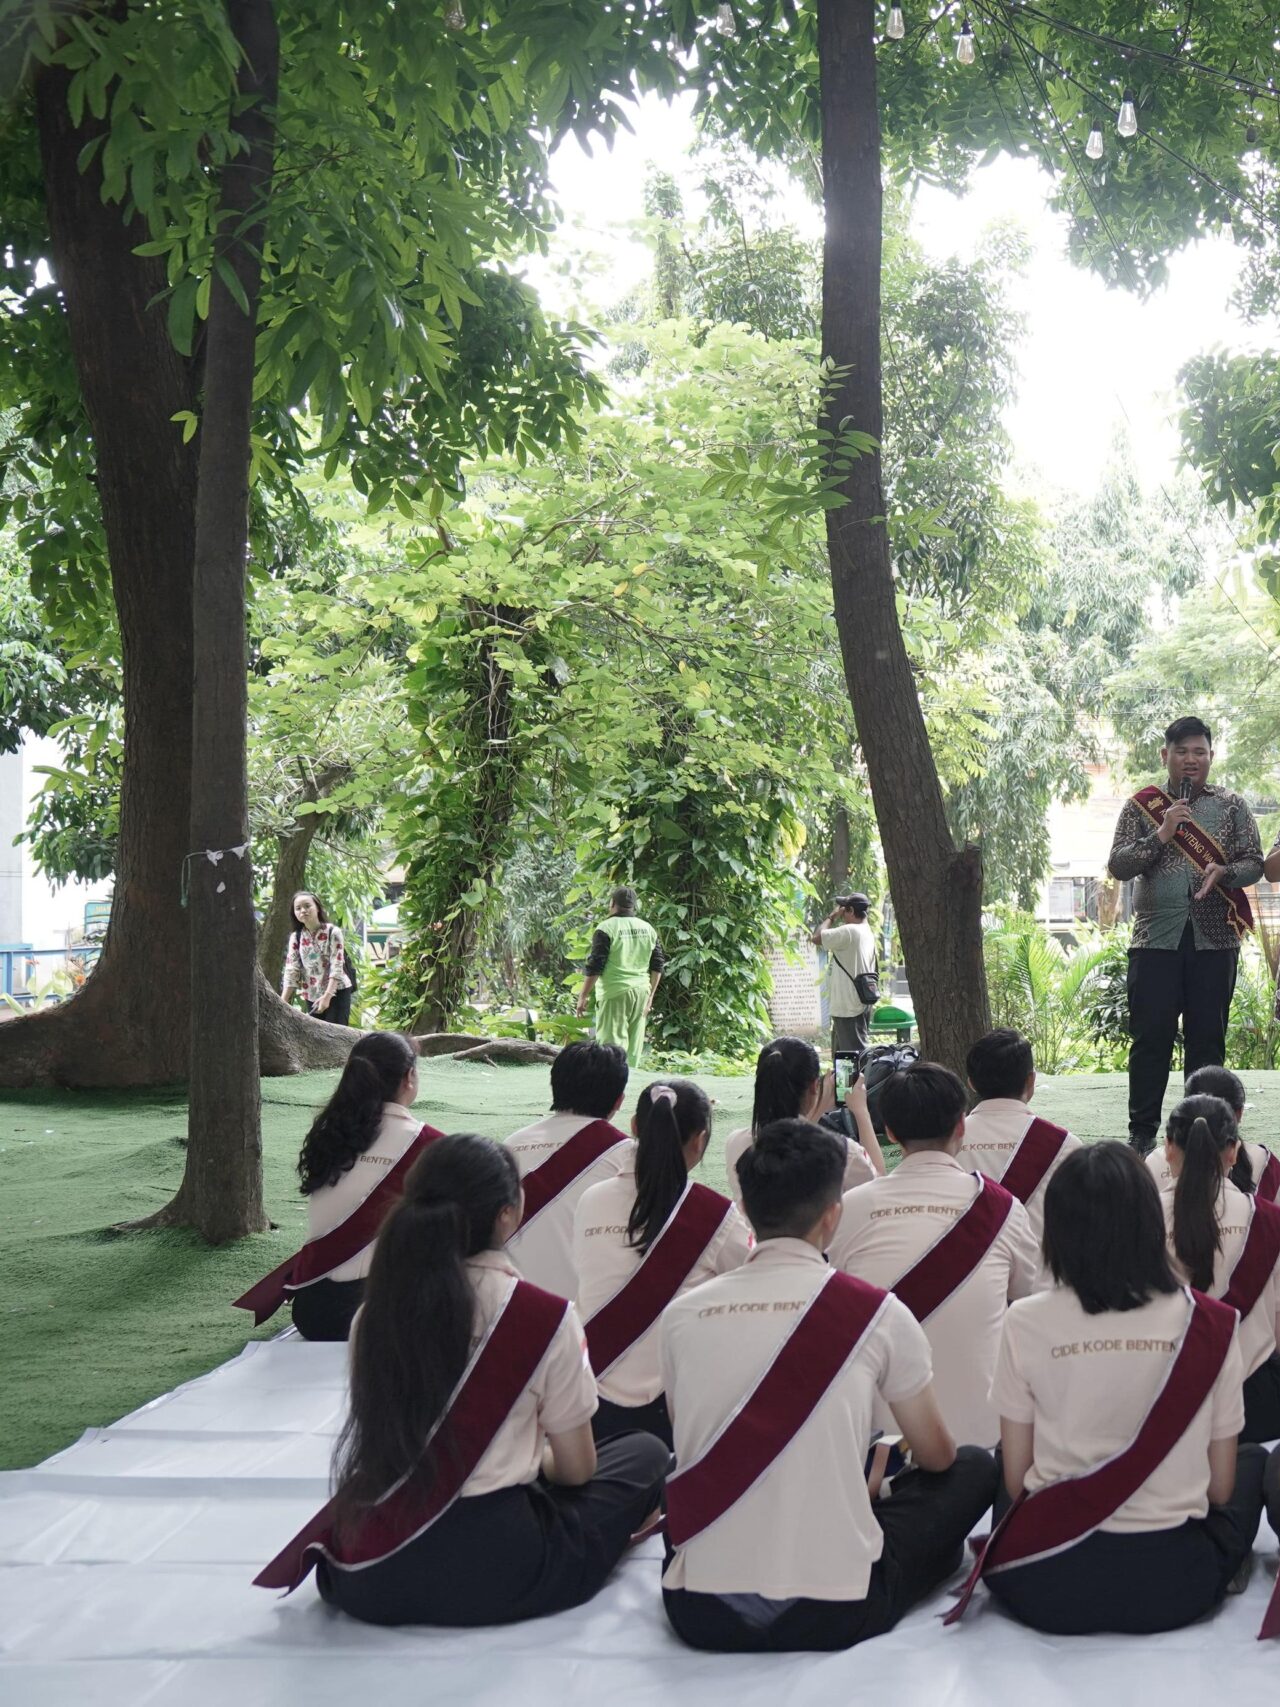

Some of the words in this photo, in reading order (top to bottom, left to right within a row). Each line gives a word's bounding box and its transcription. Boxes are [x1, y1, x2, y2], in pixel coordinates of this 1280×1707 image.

[1184, 829, 1204, 854] NTENG
[870, 1208, 892, 1220] CIDE
[894, 1206, 925, 1215] KODE
[927, 1206, 963, 1217] BENTE
[604, 1226, 629, 1234] KOD
[728, 1303, 769, 1314] KODE
[1052, 1343, 1079, 1358] CIDE
[1083, 1340, 1122, 1352] KODE
[1126, 1339, 1176, 1352] BENTEN
